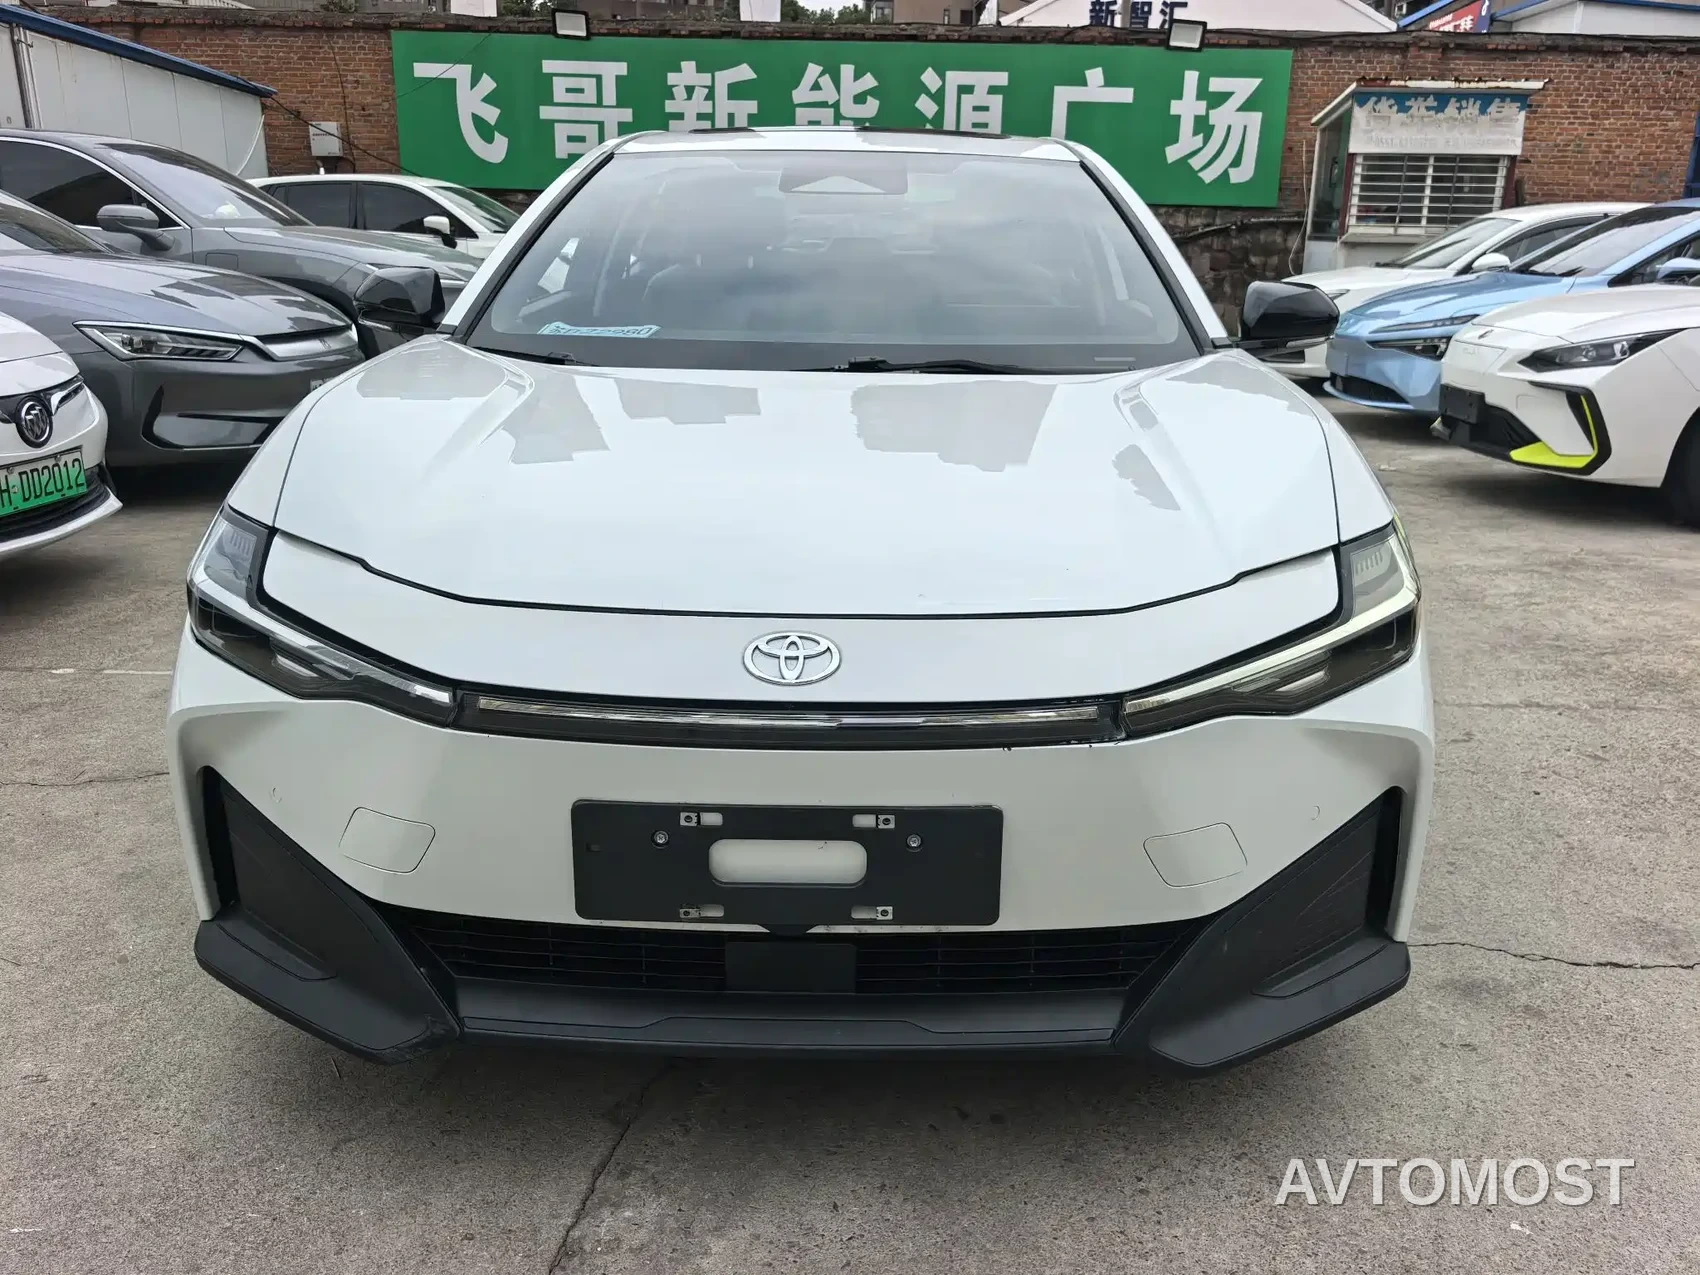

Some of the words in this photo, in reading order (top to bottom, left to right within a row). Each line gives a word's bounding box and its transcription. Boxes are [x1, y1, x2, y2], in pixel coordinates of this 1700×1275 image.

[413, 60, 1263, 184] 飞哥新能源广场
